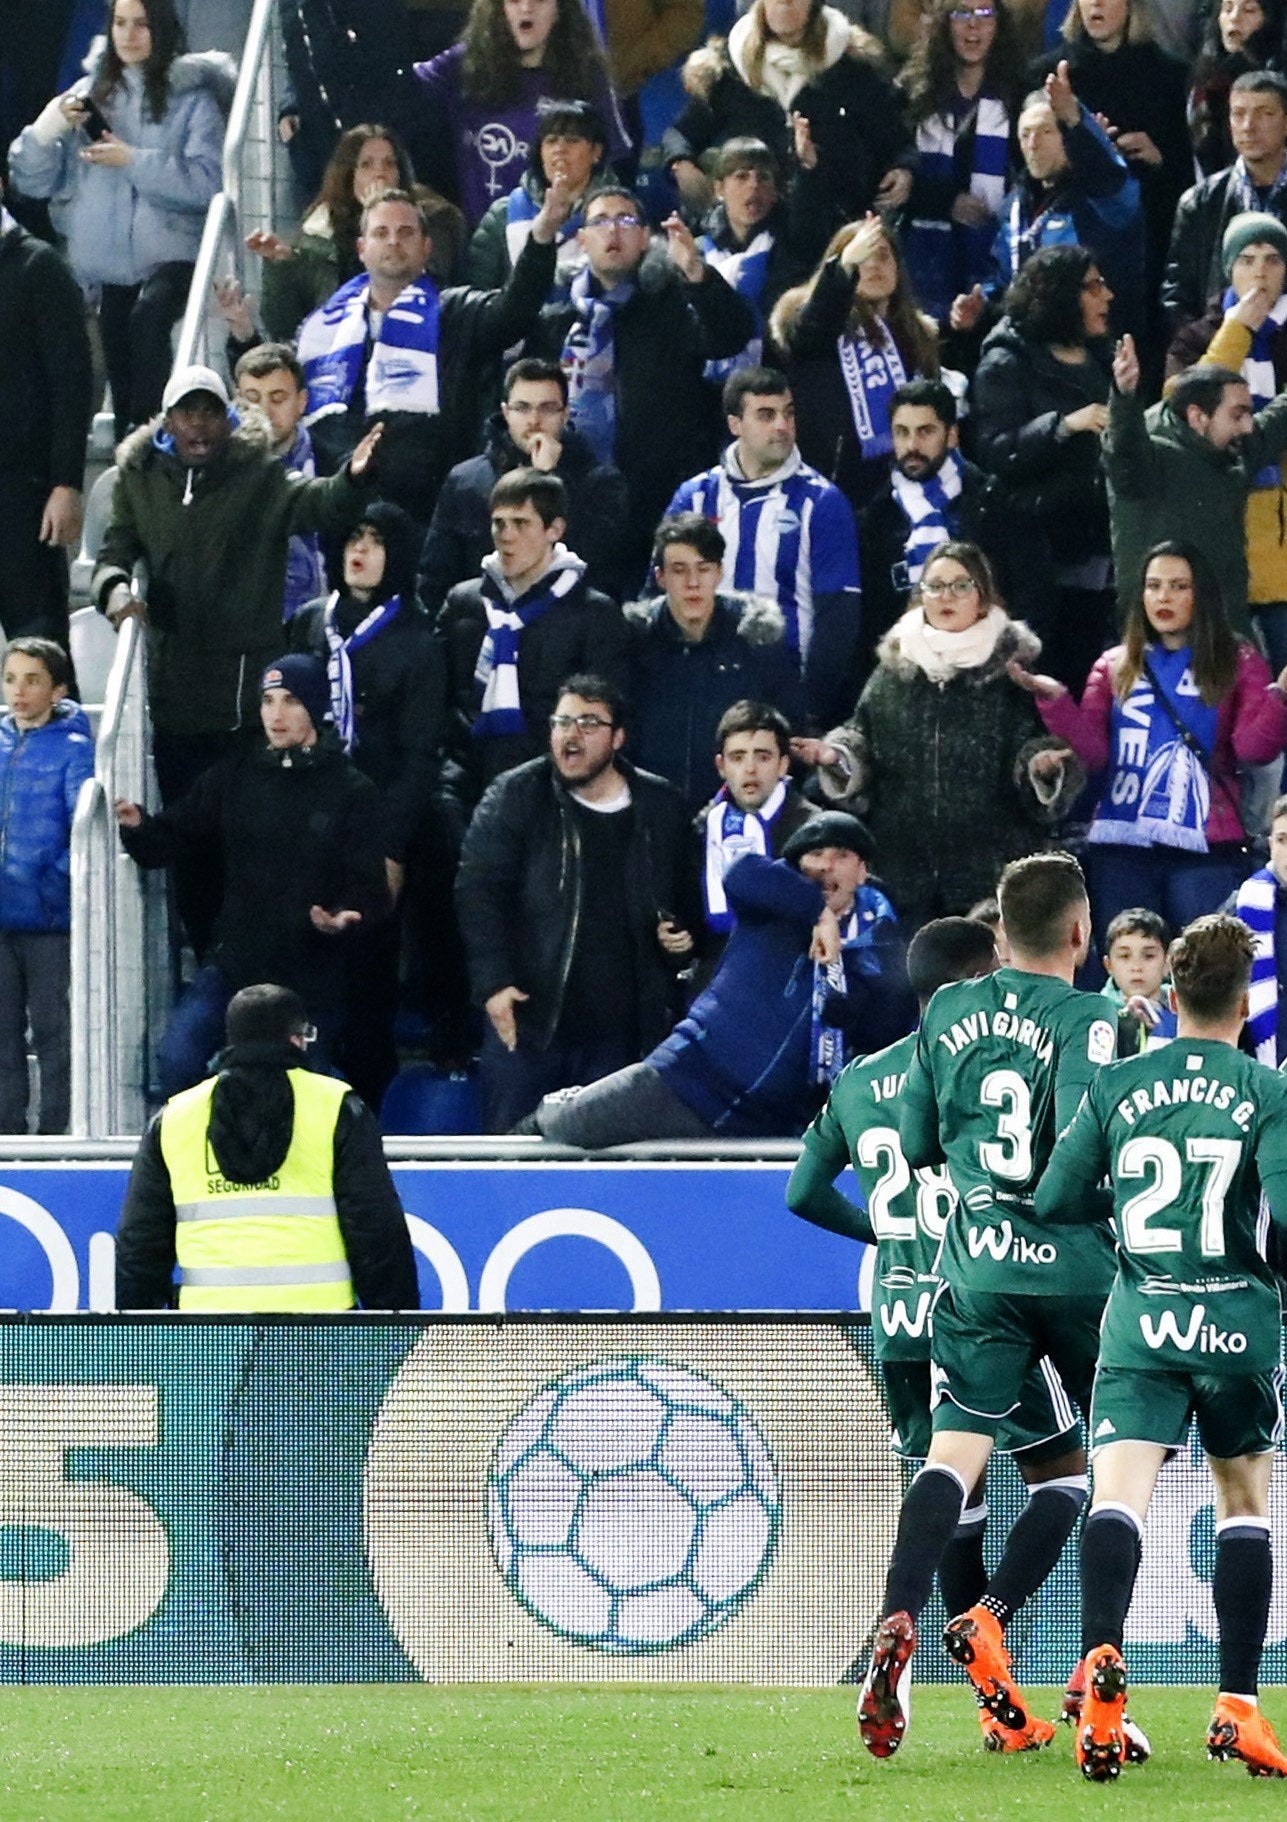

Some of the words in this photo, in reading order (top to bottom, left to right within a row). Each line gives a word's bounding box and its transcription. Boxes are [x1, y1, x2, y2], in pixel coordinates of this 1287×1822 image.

[938, 1010, 990, 1057] JAVI
[979, 1069, 1032, 1181] 3
[1117, 1077, 1236, 1126] FRANCIS
[857, 1126, 960, 1241] 28
[1117, 1136, 1243, 1257] 27
[968, 1219, 1057, 1264] Wiko
[1139, 1304, 1248, 1354] Wiko
